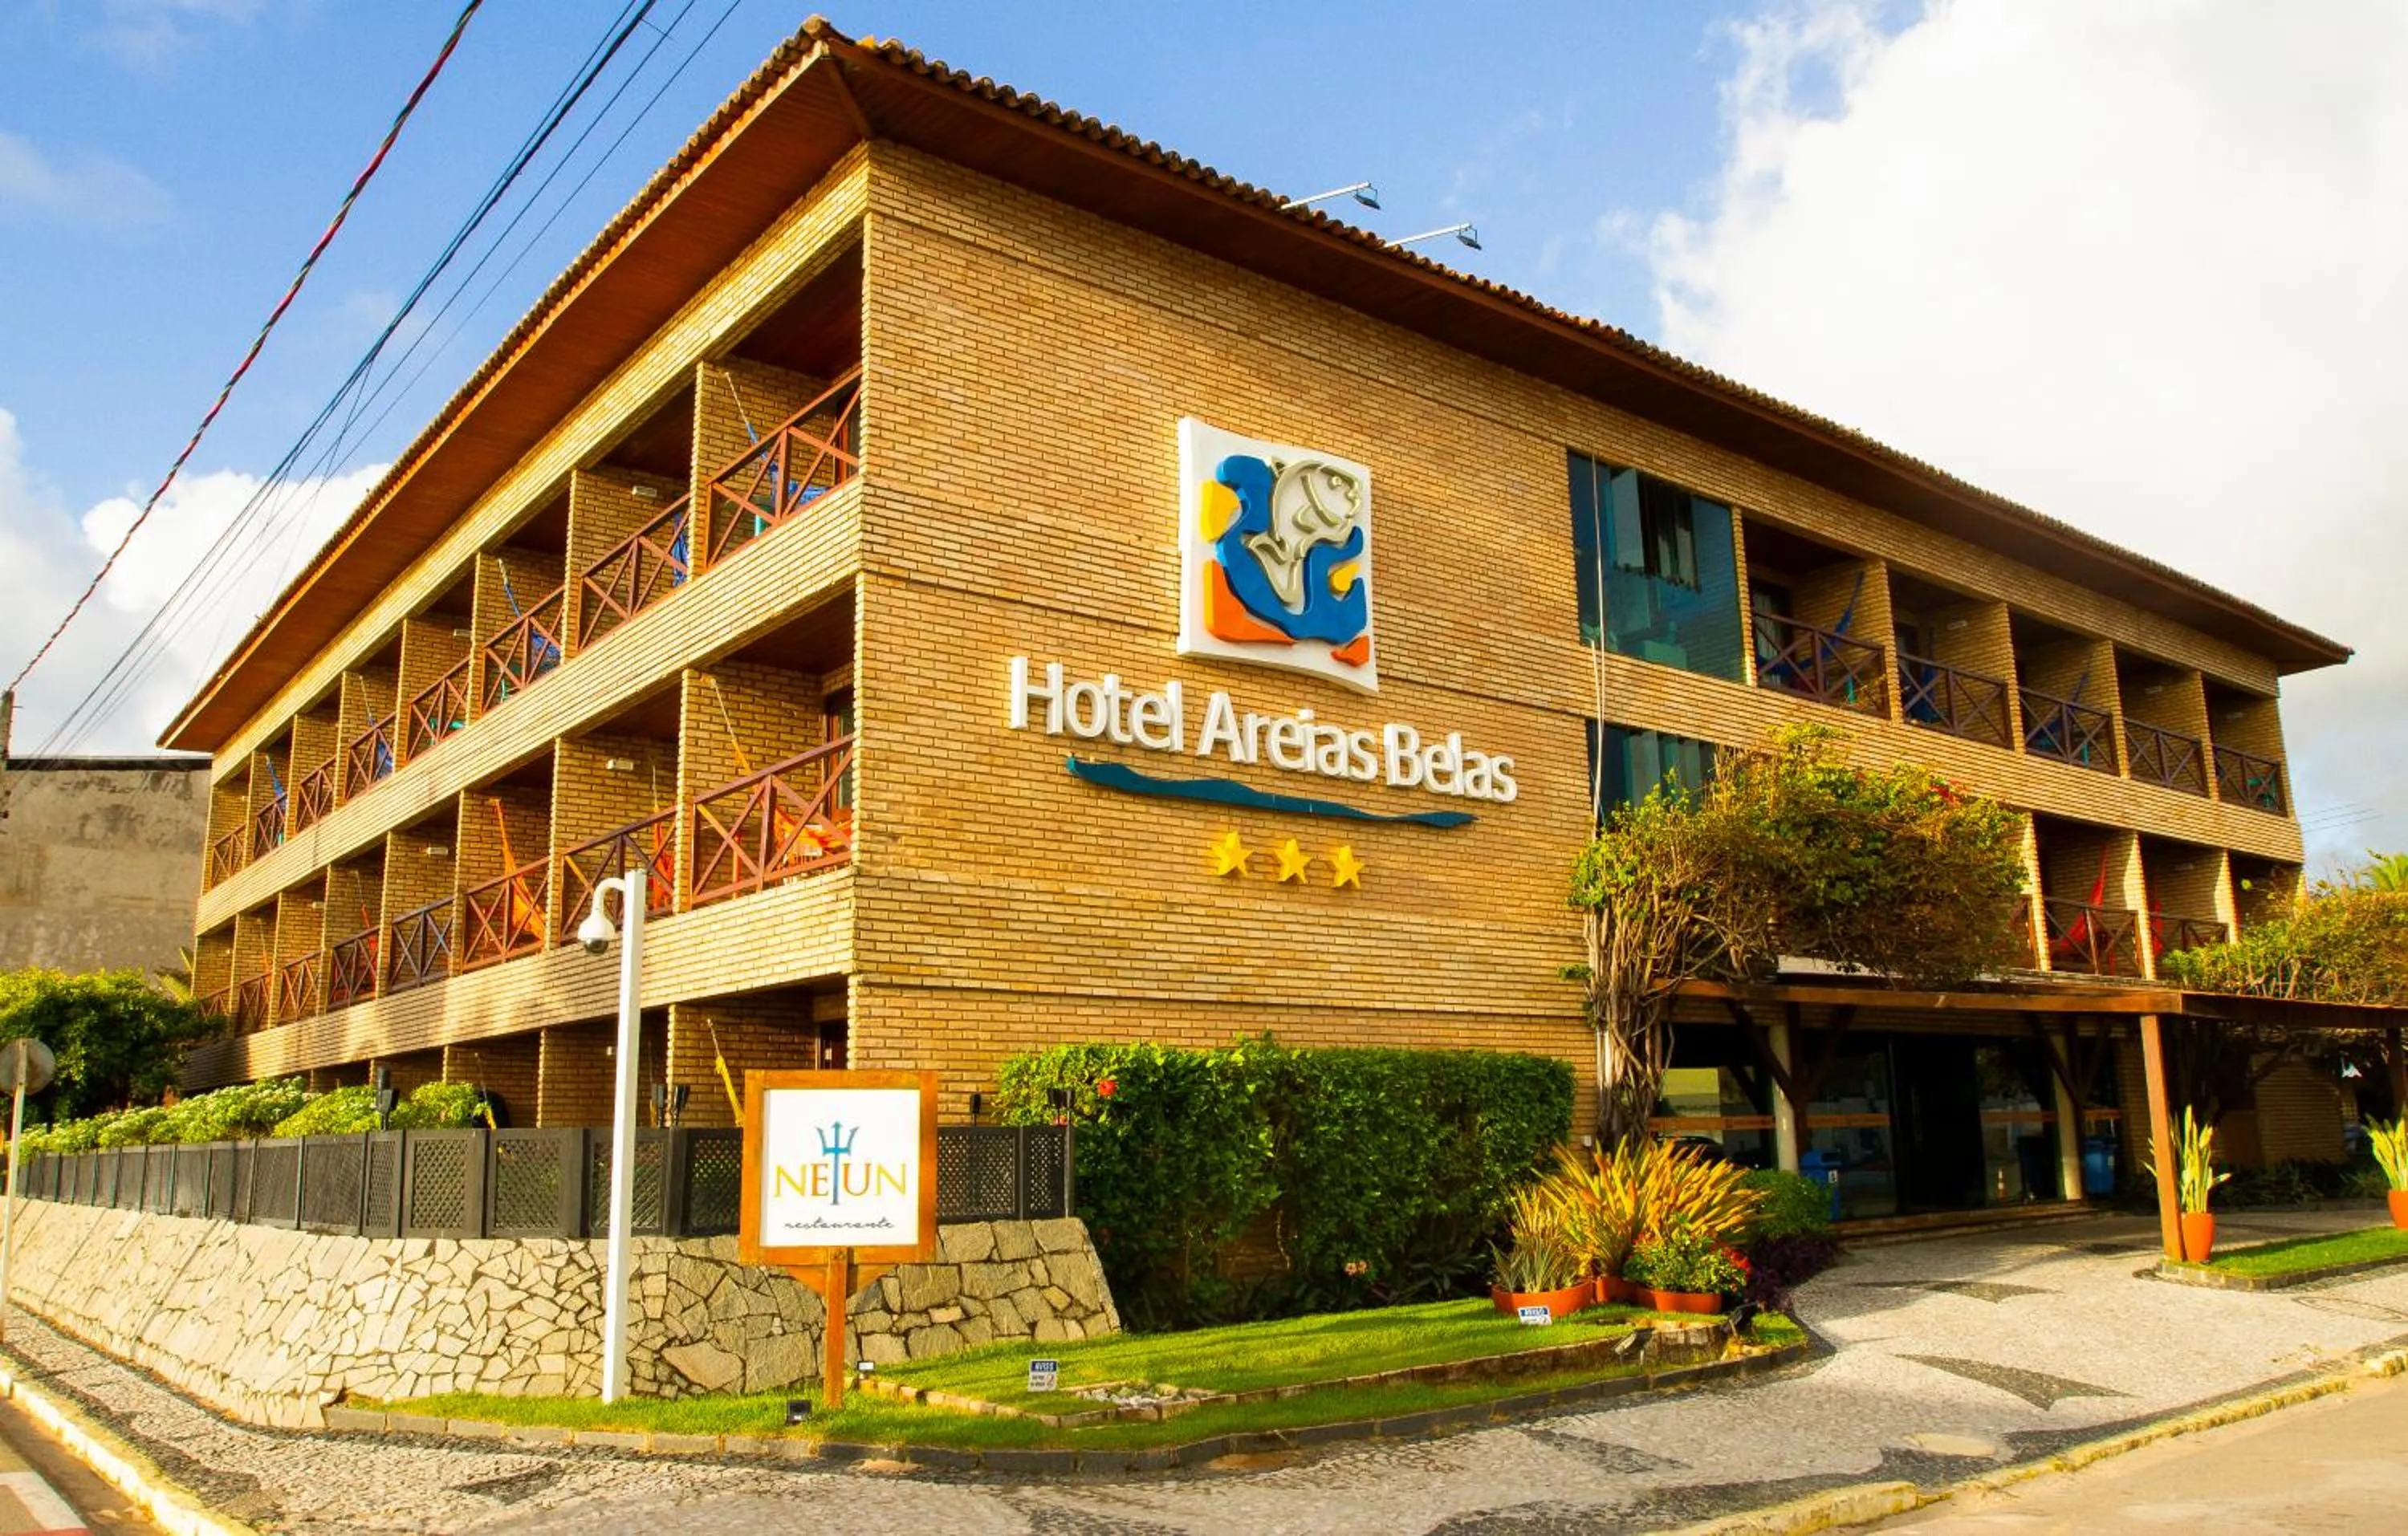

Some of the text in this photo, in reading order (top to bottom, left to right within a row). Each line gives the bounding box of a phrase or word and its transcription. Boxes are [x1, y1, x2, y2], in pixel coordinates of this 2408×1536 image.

[1009, 656, 1519, 803] Hotel Areias Belas
[784, 1216, 896, 1229] restaurante
